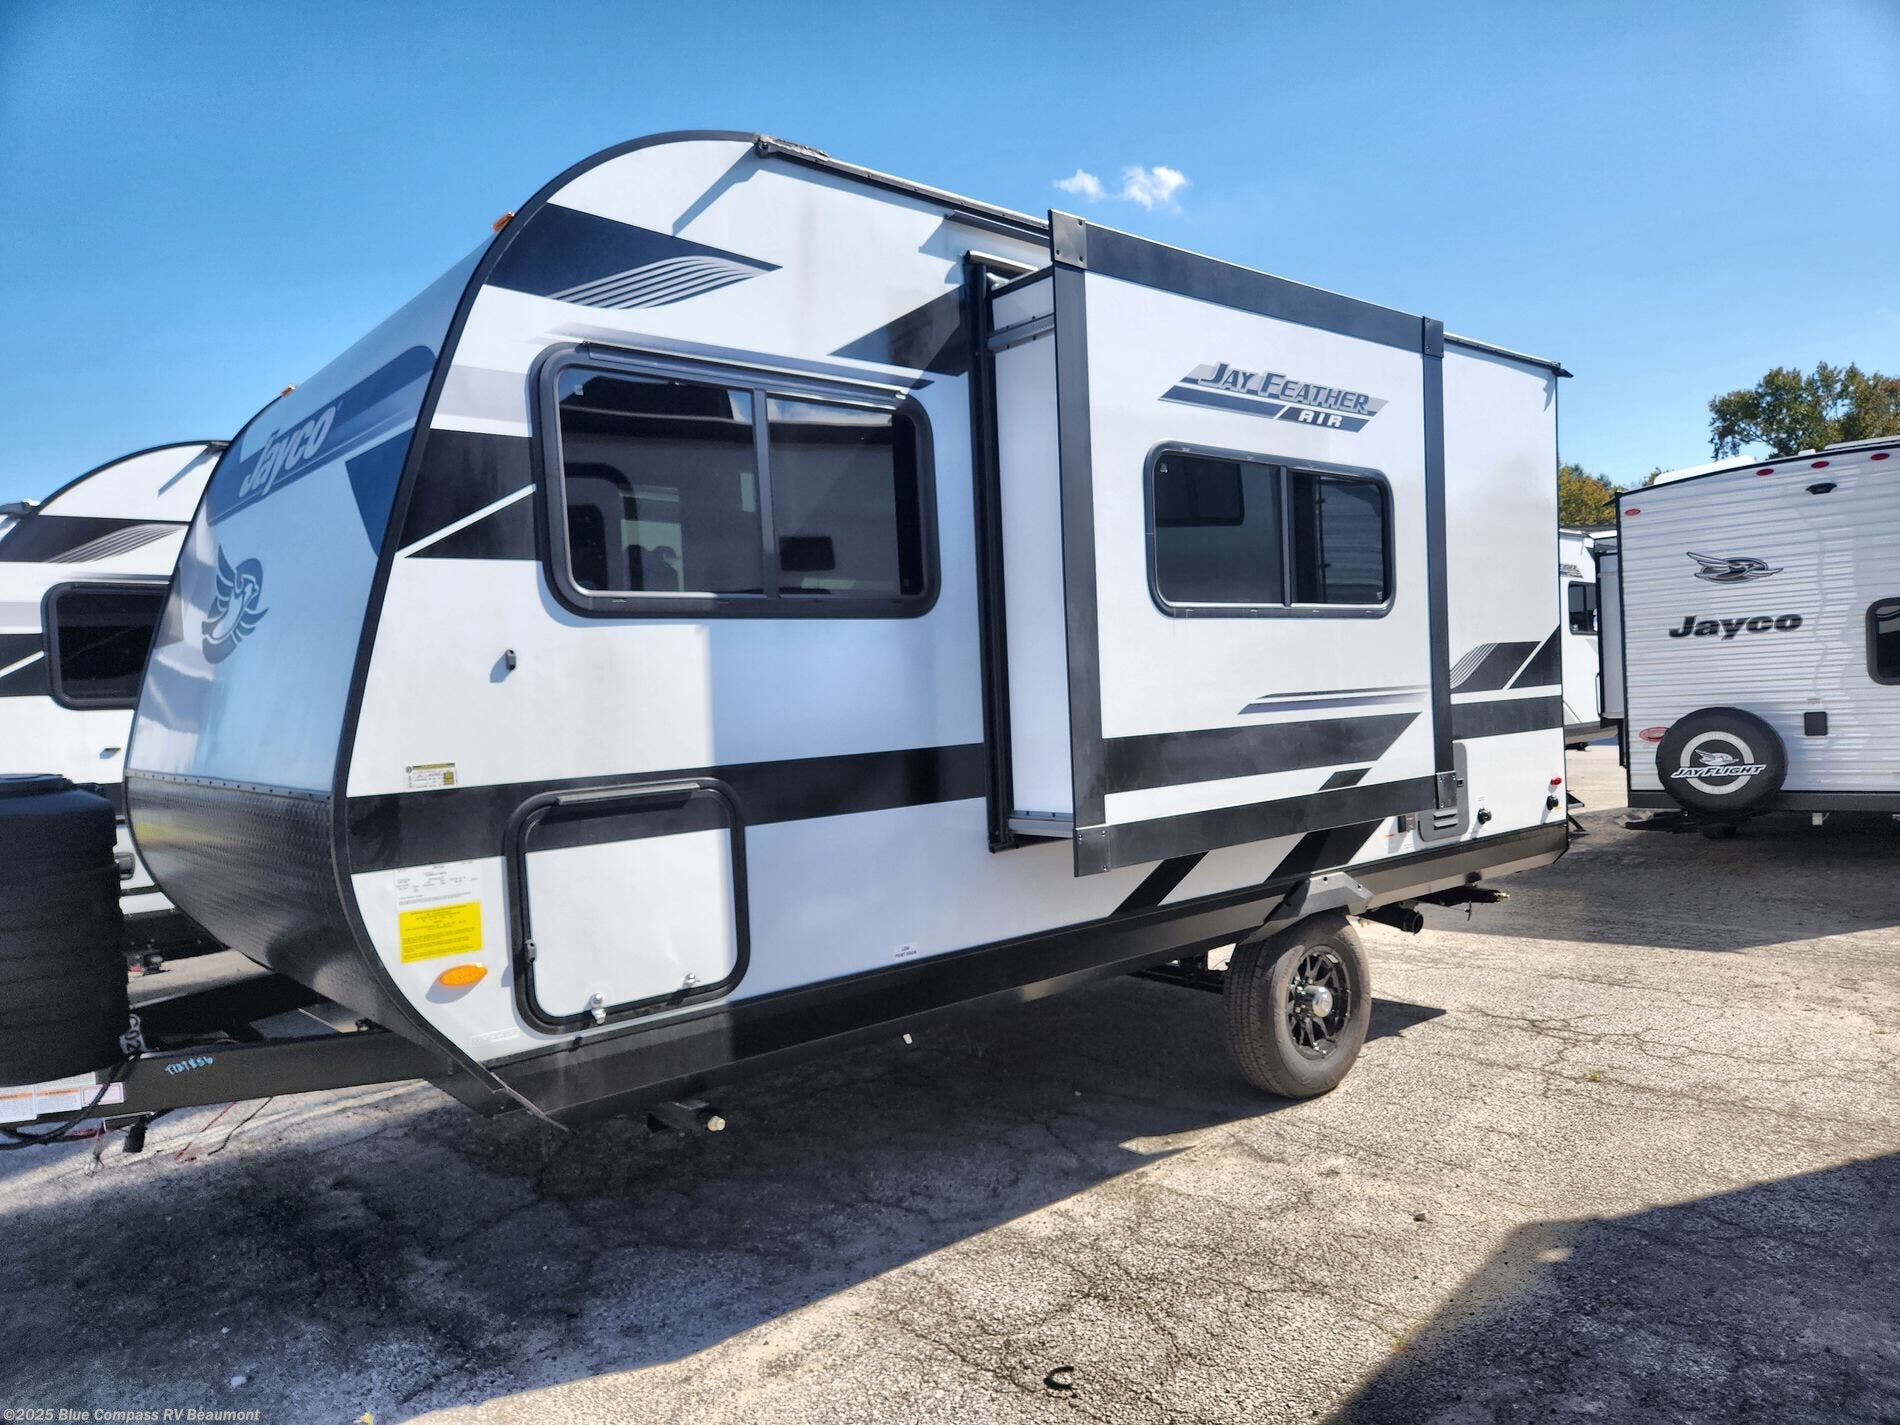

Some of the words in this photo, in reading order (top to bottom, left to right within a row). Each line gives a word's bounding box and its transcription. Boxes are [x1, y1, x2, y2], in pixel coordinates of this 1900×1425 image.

[1298, 409, 1342, 428] AIR
[238, 405, 336, 499] Jayco
[1668, 613, 1803, 641] Jayco
